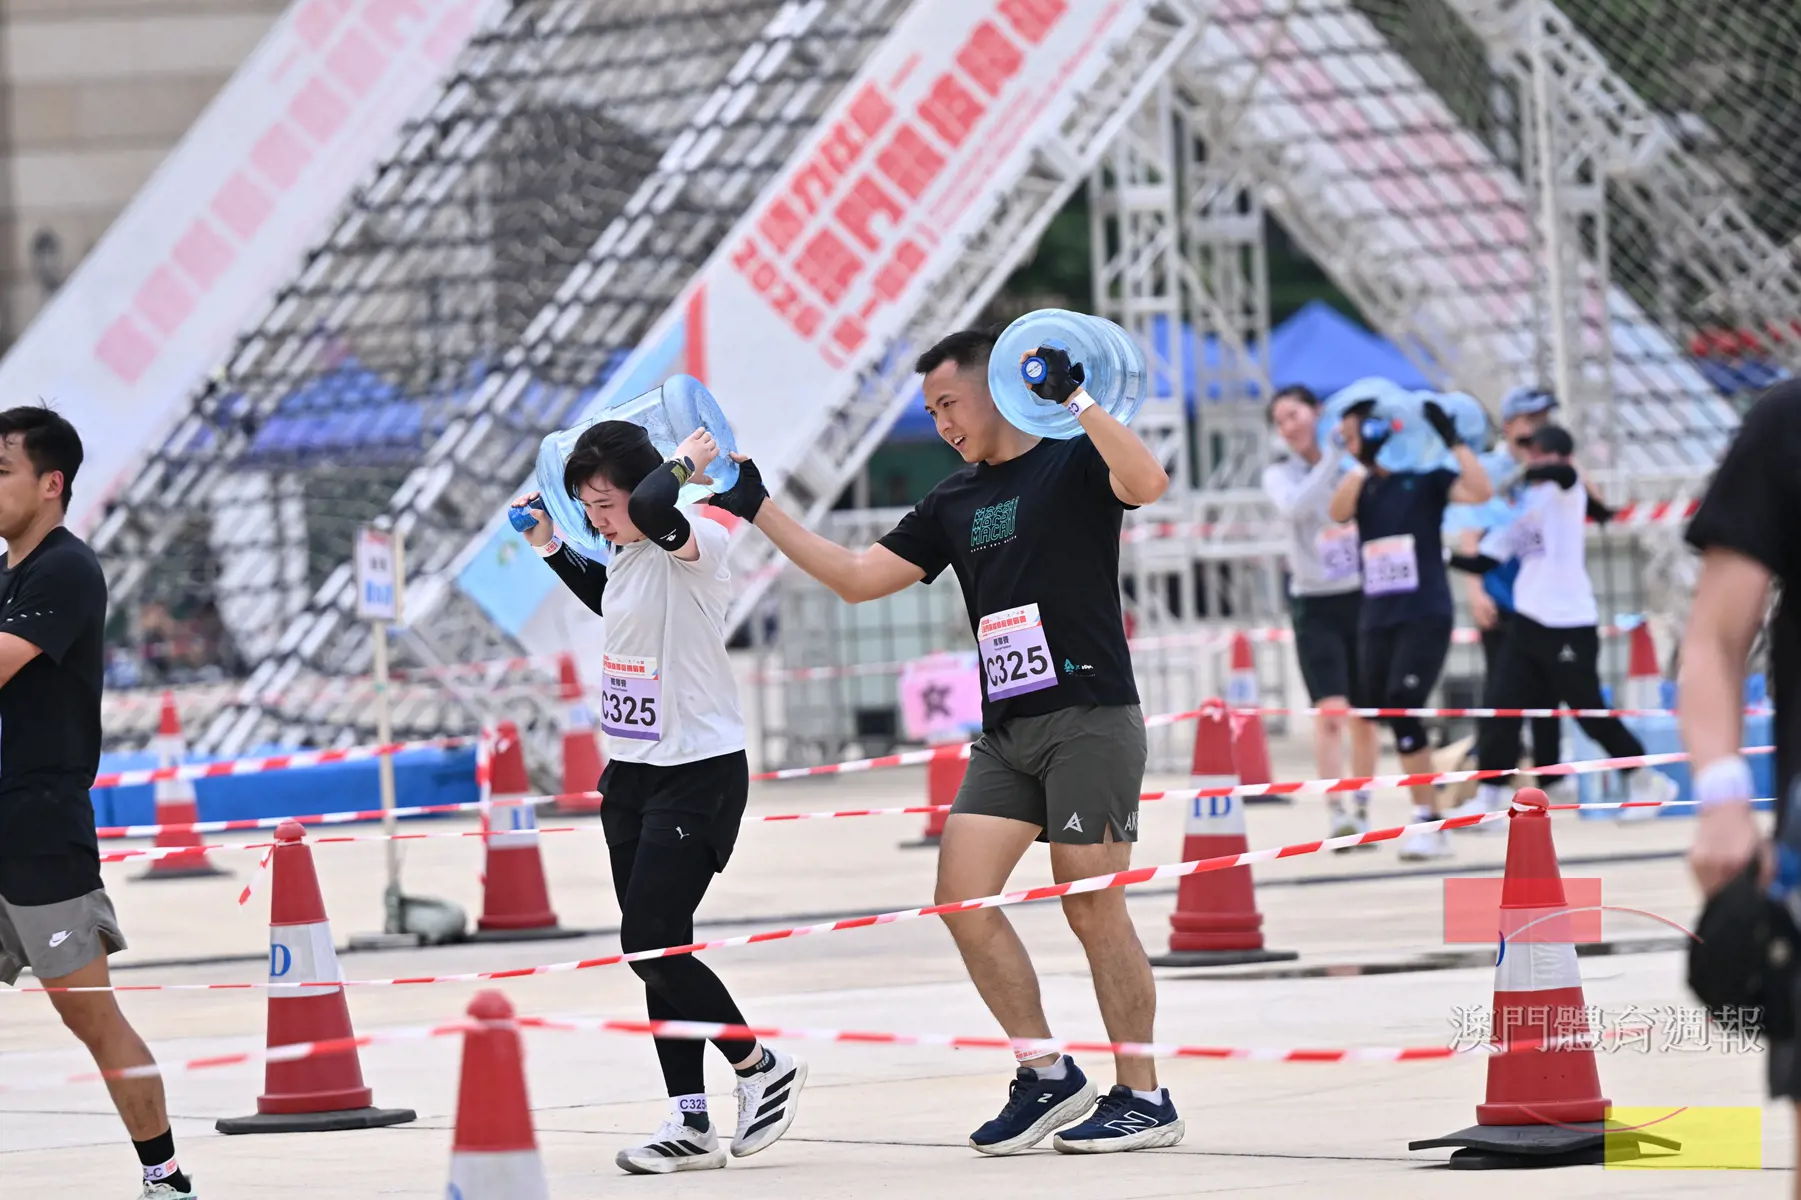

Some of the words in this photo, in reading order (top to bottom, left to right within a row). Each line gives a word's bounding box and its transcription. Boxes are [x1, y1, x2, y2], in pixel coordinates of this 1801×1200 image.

[987, 645, 1048, 687] C325
[602, 690, 656, 726] C325
[270, 943, 292, 976] D
[680, 1099, 707, 1110] C325
